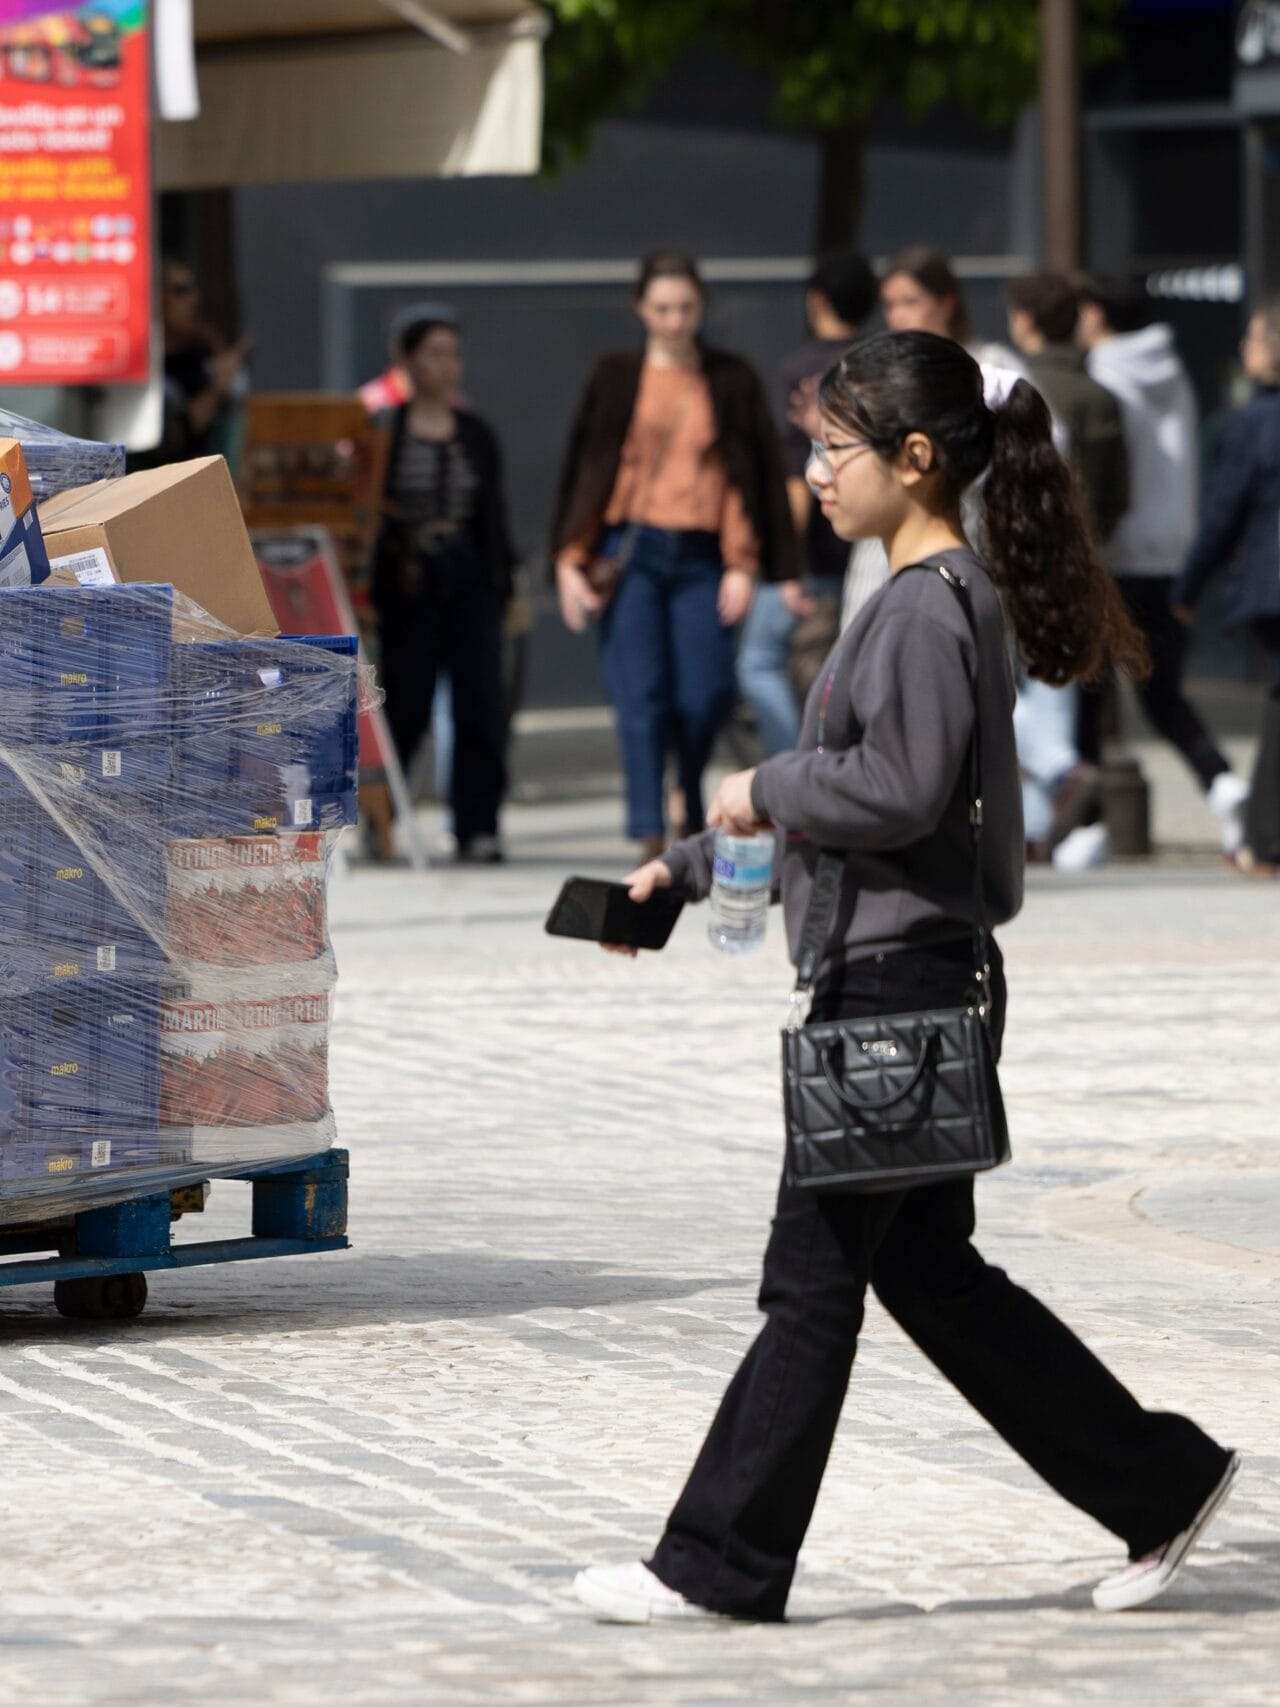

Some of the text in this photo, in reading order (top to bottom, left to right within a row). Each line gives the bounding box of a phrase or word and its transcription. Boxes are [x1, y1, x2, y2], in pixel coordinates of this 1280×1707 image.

[60, 671, 87, 684] makro
[256, 722, 282, 735] makro
[253, 815, 278, 829] makro
[55, 867, 84, 881] makro
[54, 963, 80, 978] makro
[50, 1061, 79, 1076] makro
[48, 1158, 73, 1173] makro
